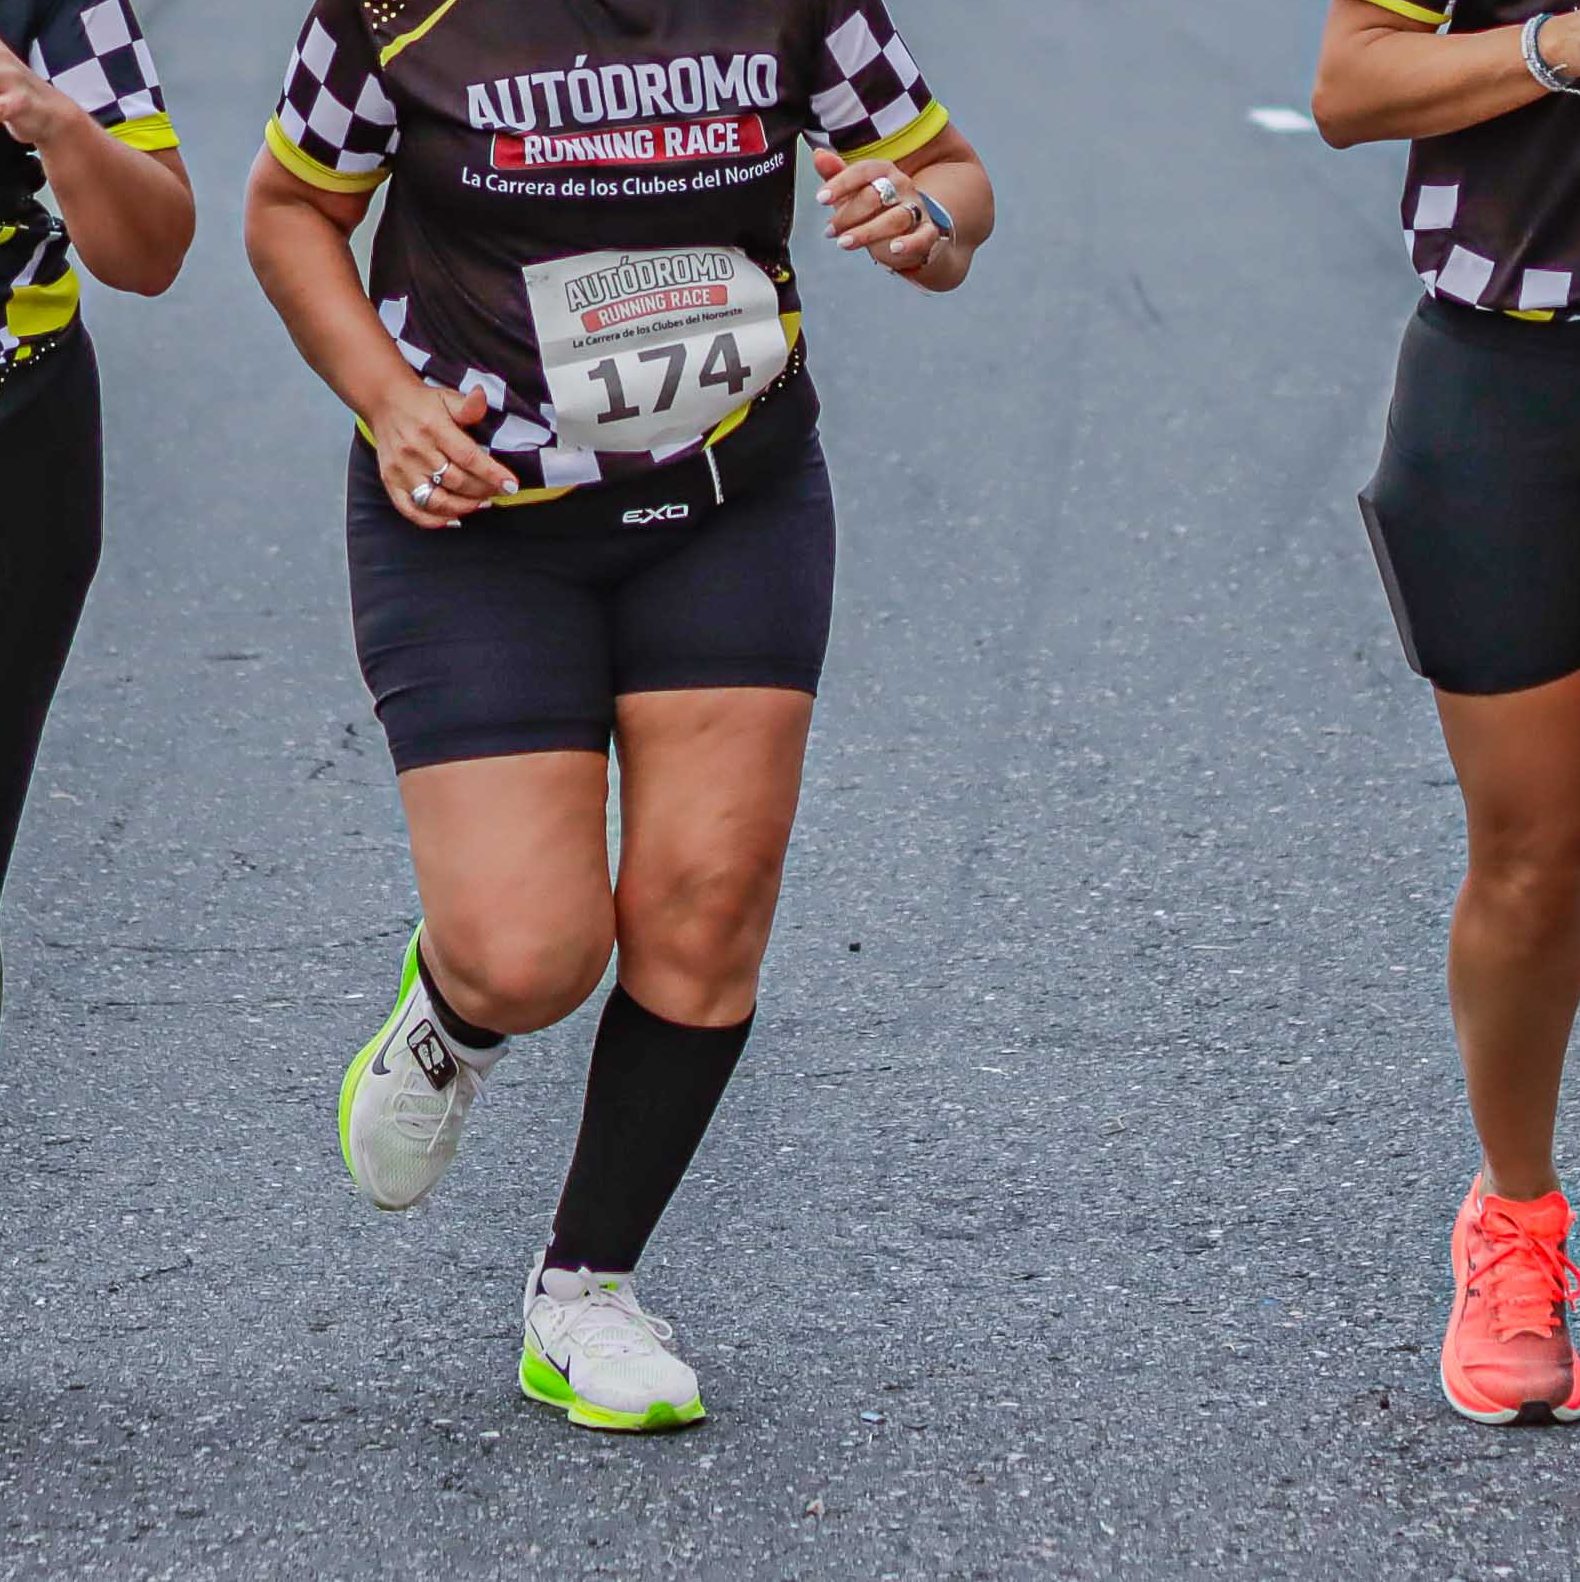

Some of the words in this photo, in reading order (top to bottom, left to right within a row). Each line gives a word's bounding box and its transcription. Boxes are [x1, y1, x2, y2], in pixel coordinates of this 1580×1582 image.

[466, 53, 779, 132] AUTÓDROMO
[523, 128, 655, 165] RUNNING
[663, 121, 741, 158] RACE
[461, 166, 481, 187] La
[485, 174, 556, 197] Carrera
[561, 177, 586, 196] de
[590, 178, 618, 196] los
[622, 172, 687, 195] Clubes
[691, 168, 721, 190] del
[725, 151, 785, 185] Noroeste
[565, 253, 734, 313] AUTÓDROMO
[598, 292, 666, 327] RUNNING
[671, 288, 711, 307] RACE
[572, 338, 584, 349] La
[585, 334, 621, 346] Carrera
[622, 328, 635, 338] de
[636, 325, 651, 335] los
[652, 319, 684, 332] Clubes
[685, 314, 701, 325] del
[587, 332, 752, 425] 174
[622, 504, 689, 524] EXO
